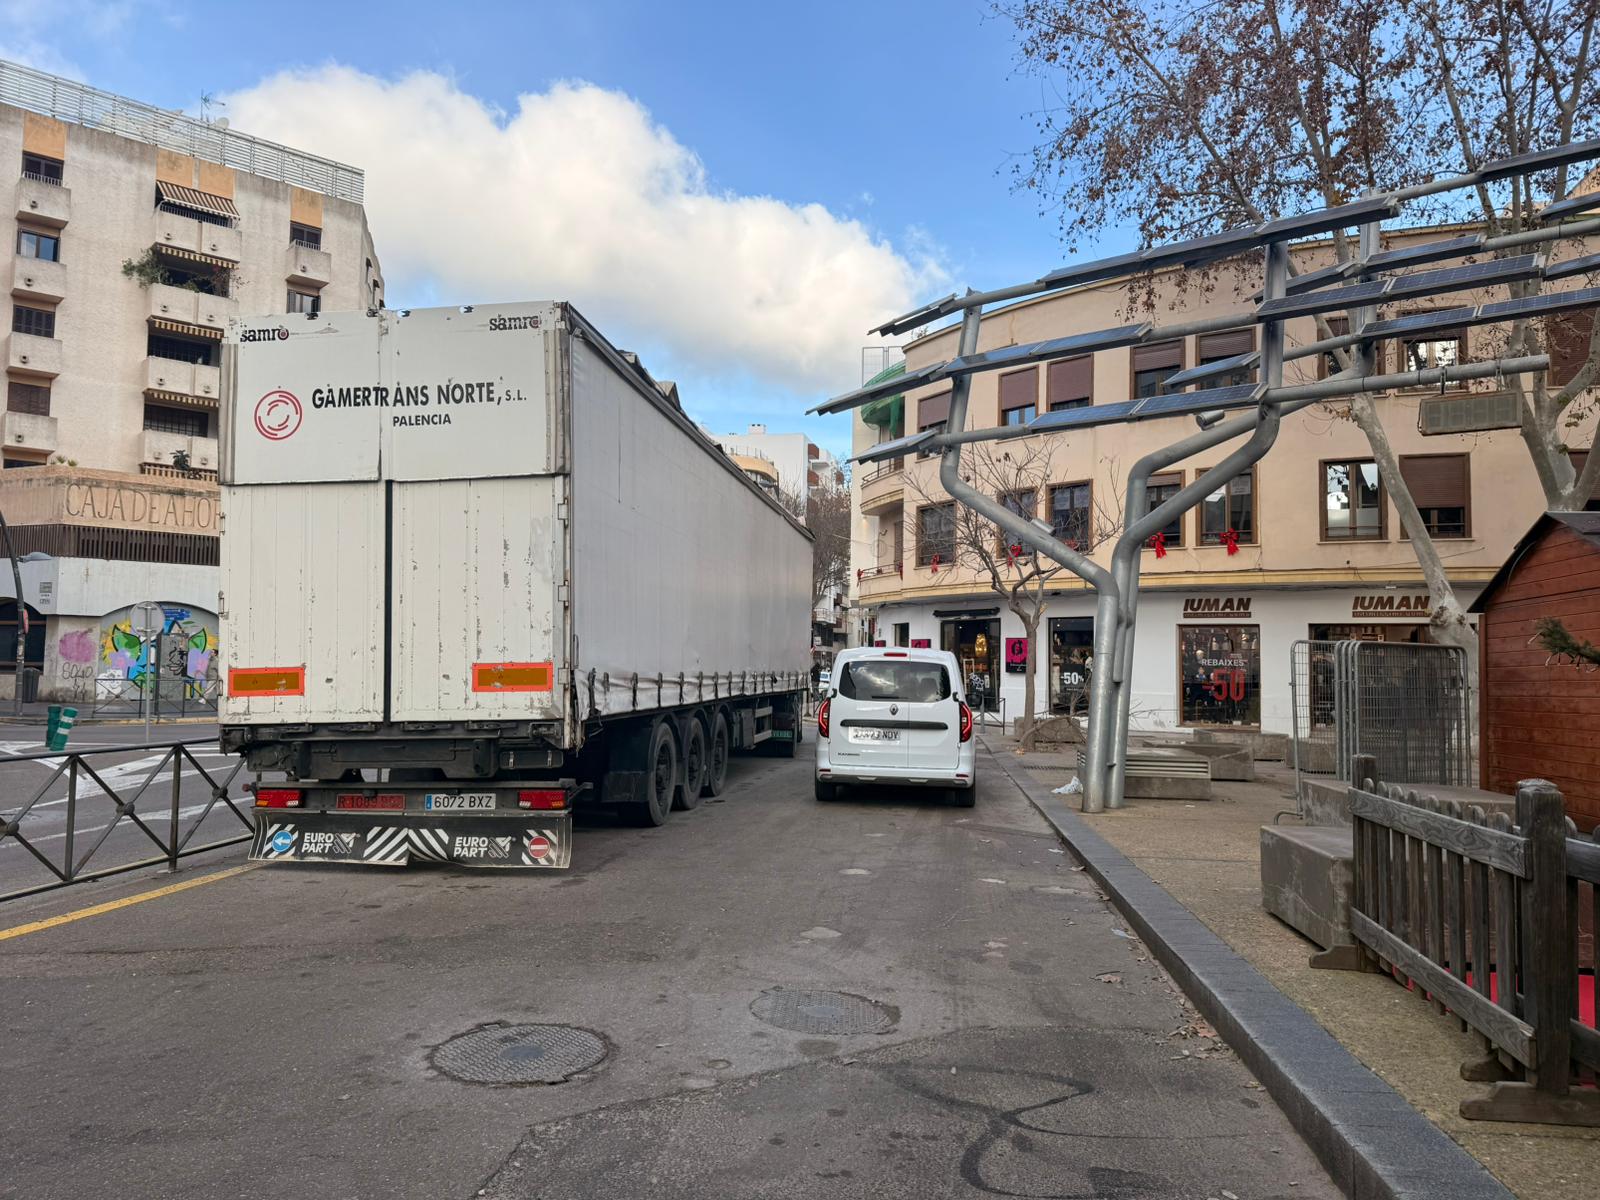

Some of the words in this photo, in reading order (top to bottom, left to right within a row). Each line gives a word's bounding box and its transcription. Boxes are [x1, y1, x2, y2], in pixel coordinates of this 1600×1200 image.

[240, 328, 289, 342] samro
[311, 385, 429, 409] GAMERTRANS
[436, 382, 502, 405] NORTE,
[505, 390, 527, 401] S.L.
[392, 413, 451, 427] PALENCIA
[65, 483, 126, 521] CAJA
[131, 490, 160, 524] DE
[1183, 597, 1252, 611] IUMAN
[1352, 595, 1431, 611] IUMAN
[1201, 658, 1245, 667] REBAIXES
[434, 796, 466, 808] 6072
[468, 796, 493, 809] BXZ
[303, 832, 334, 843] EURO
[454, 836, 489, 848] EURO
[301, 842, 333, 854] PART
[453, 847, 488, 858] PART
